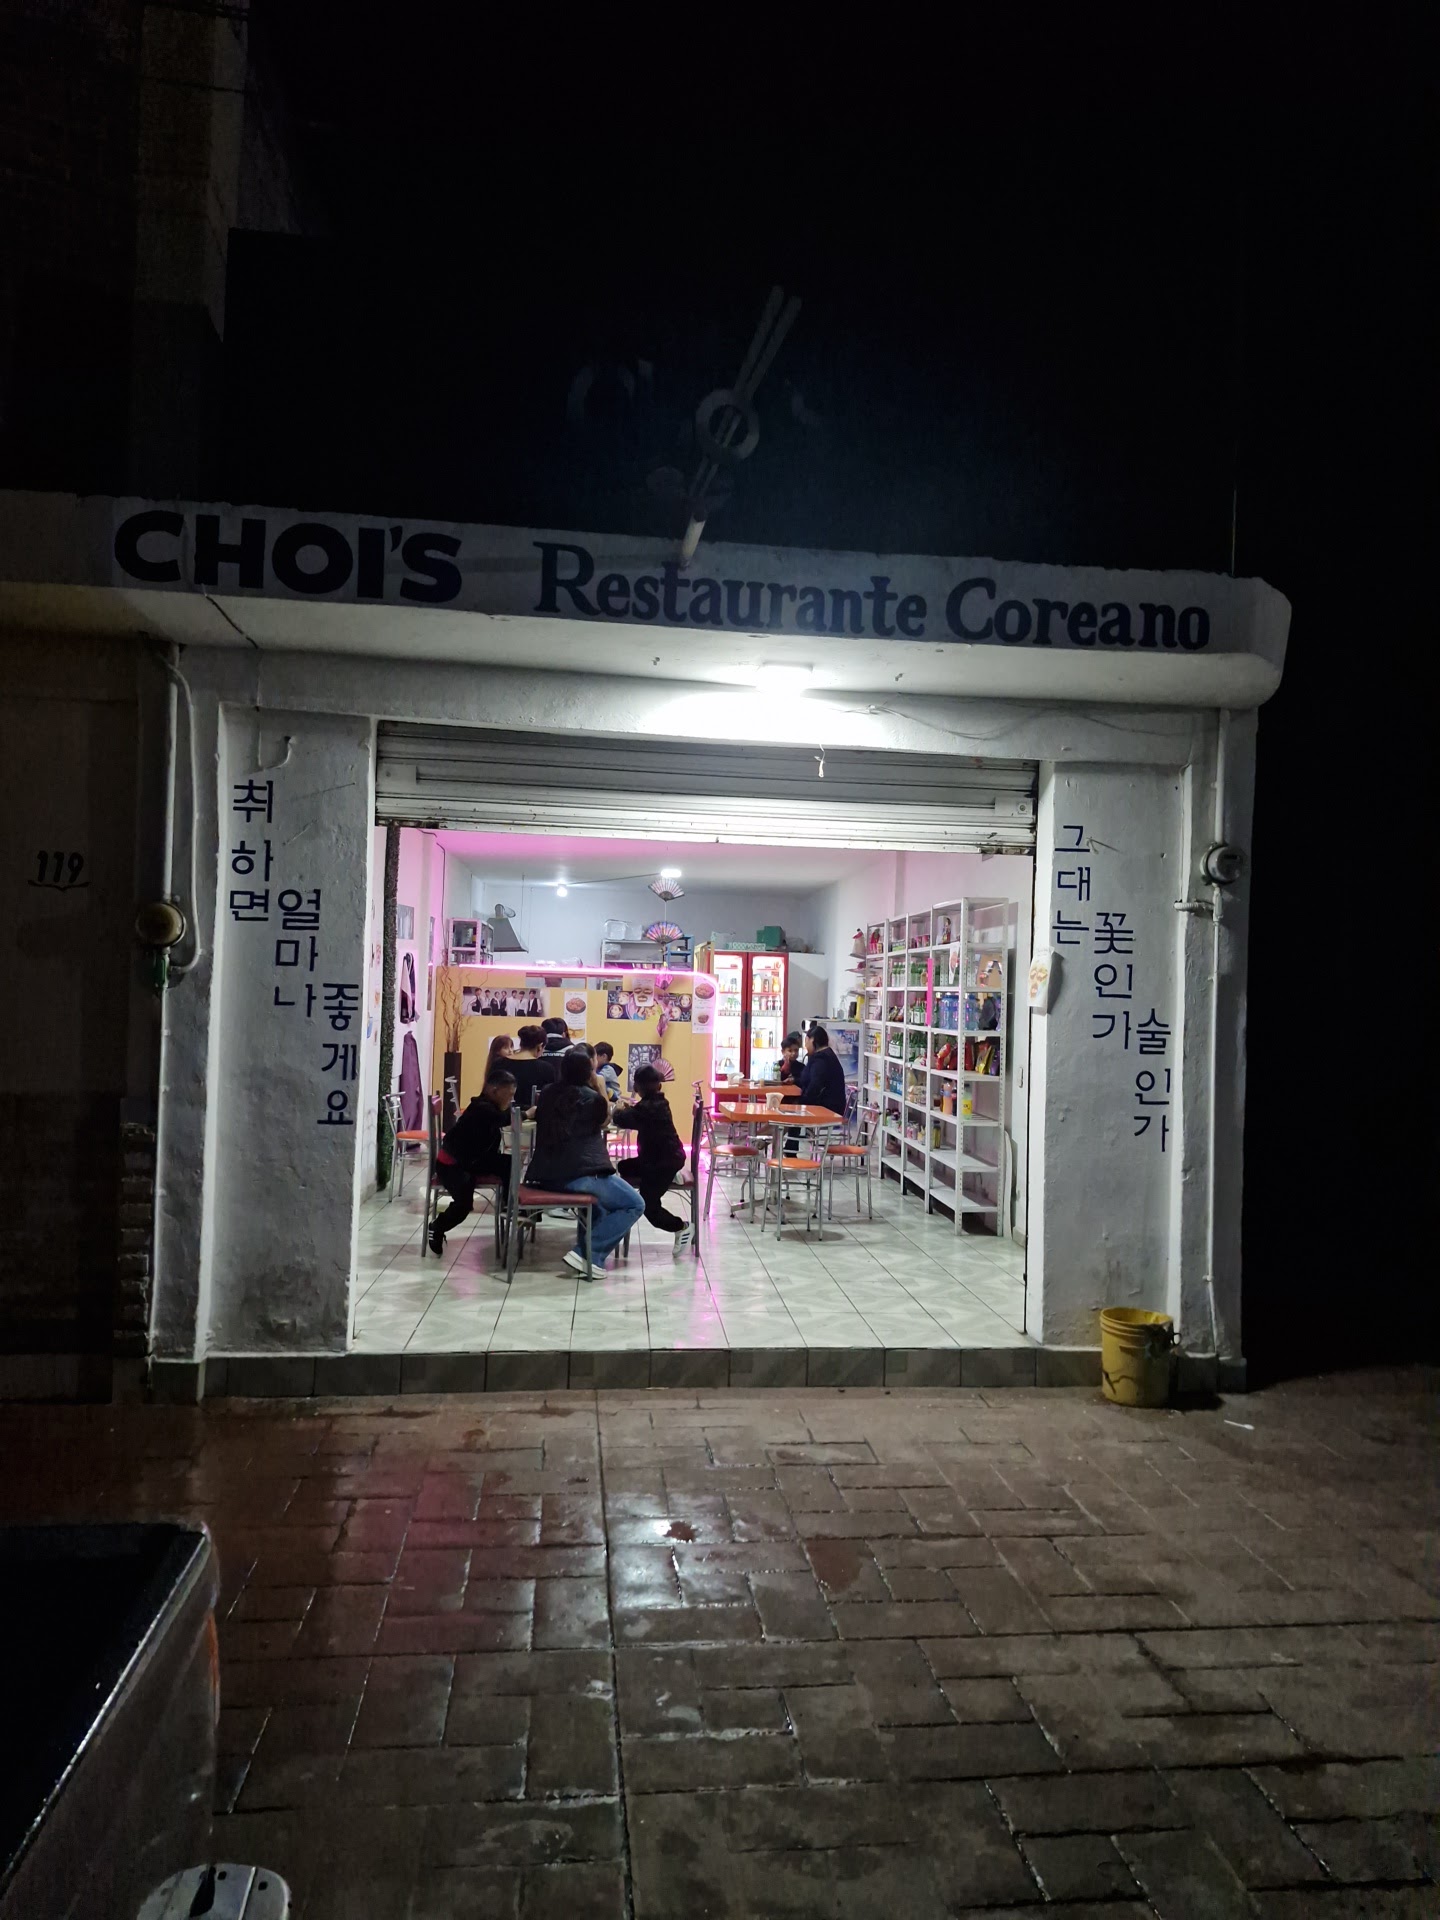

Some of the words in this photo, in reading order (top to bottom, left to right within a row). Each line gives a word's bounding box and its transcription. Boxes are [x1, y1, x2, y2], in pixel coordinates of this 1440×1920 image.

[114, 509, 463, 603] CHOI'S
[532, 541, 927, 636] Restaurante
[944, 576, 1211, 652] Coreano
[36, 850, 84, 883] 119
[229, 779, 274, 922] 취하면
[1052, 825, 1091, 944] 그대는
[274, 889, 322, 1018] 얼마나
[1092, 912, 1134, 1050] 꽃인가
[317, 983, 359, 1125] 좋게요
[1133, 1007, 1172, 1153] 술인가
